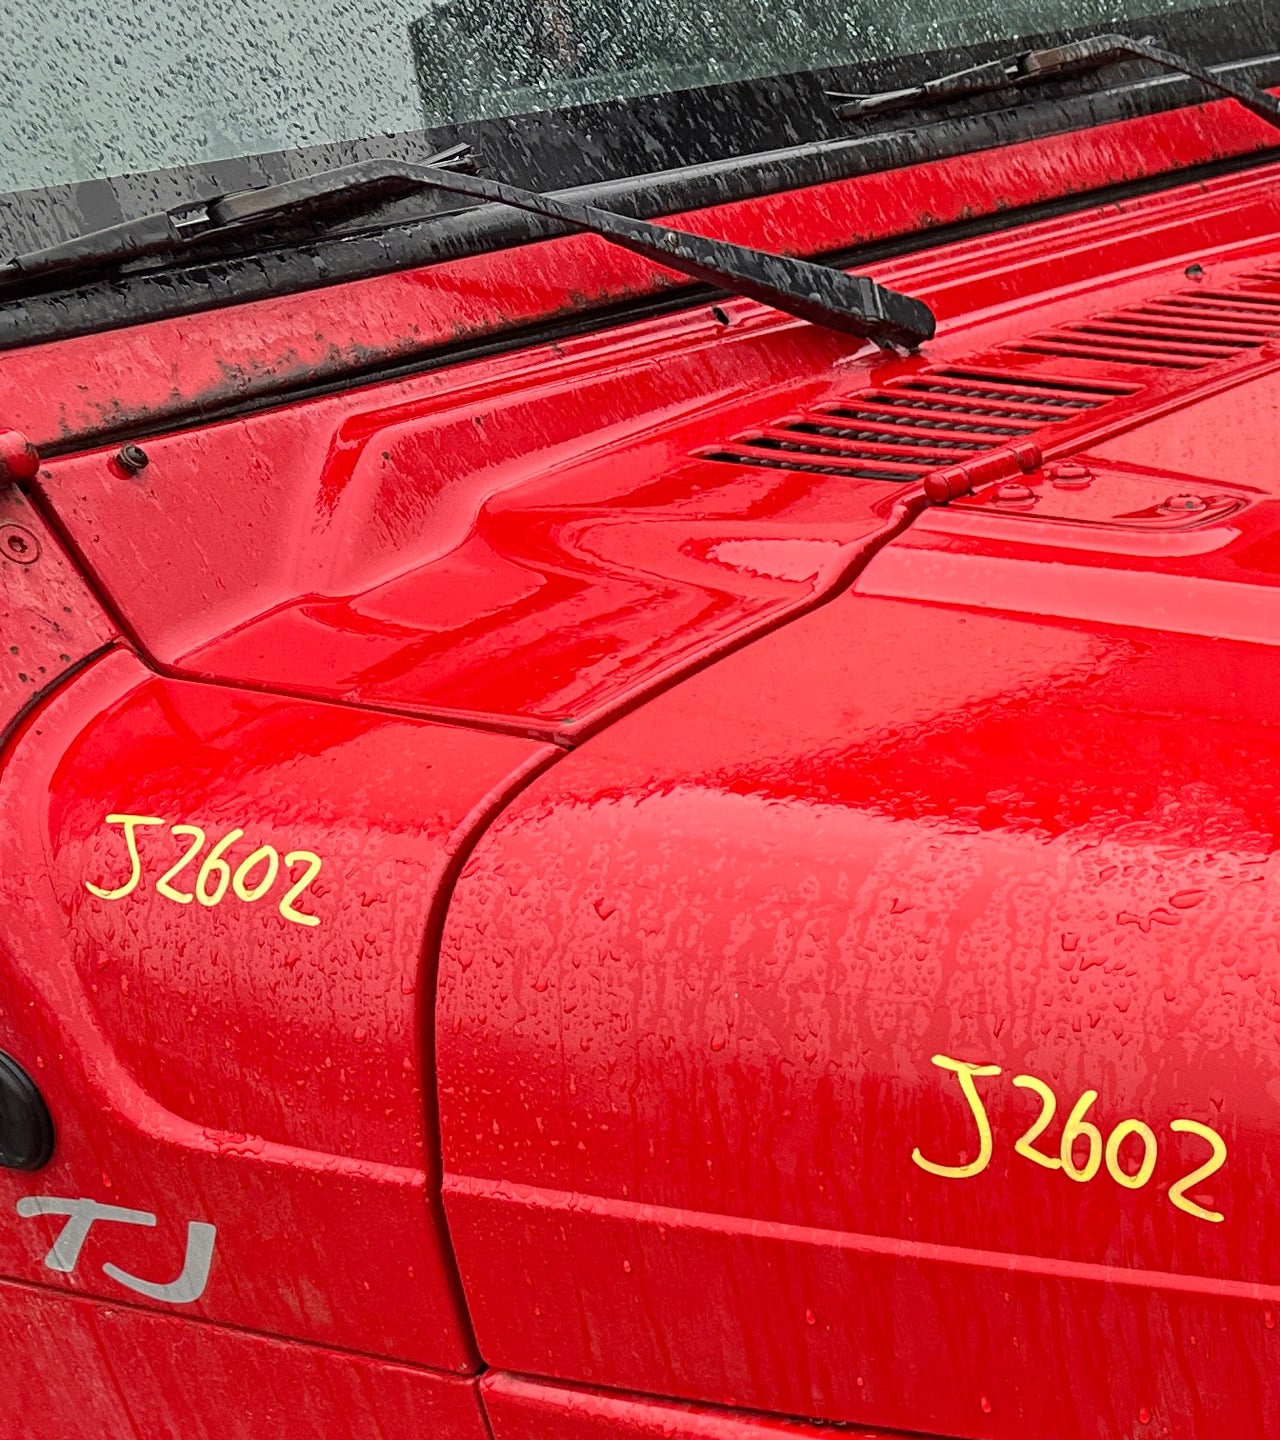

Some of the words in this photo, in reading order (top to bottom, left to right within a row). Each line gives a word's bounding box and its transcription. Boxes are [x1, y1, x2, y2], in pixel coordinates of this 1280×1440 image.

[86, 813, 322, 927] J2602
[911, 1054, 1228, 1223] J2602
[16, 1196, 216, 1303] TJ
